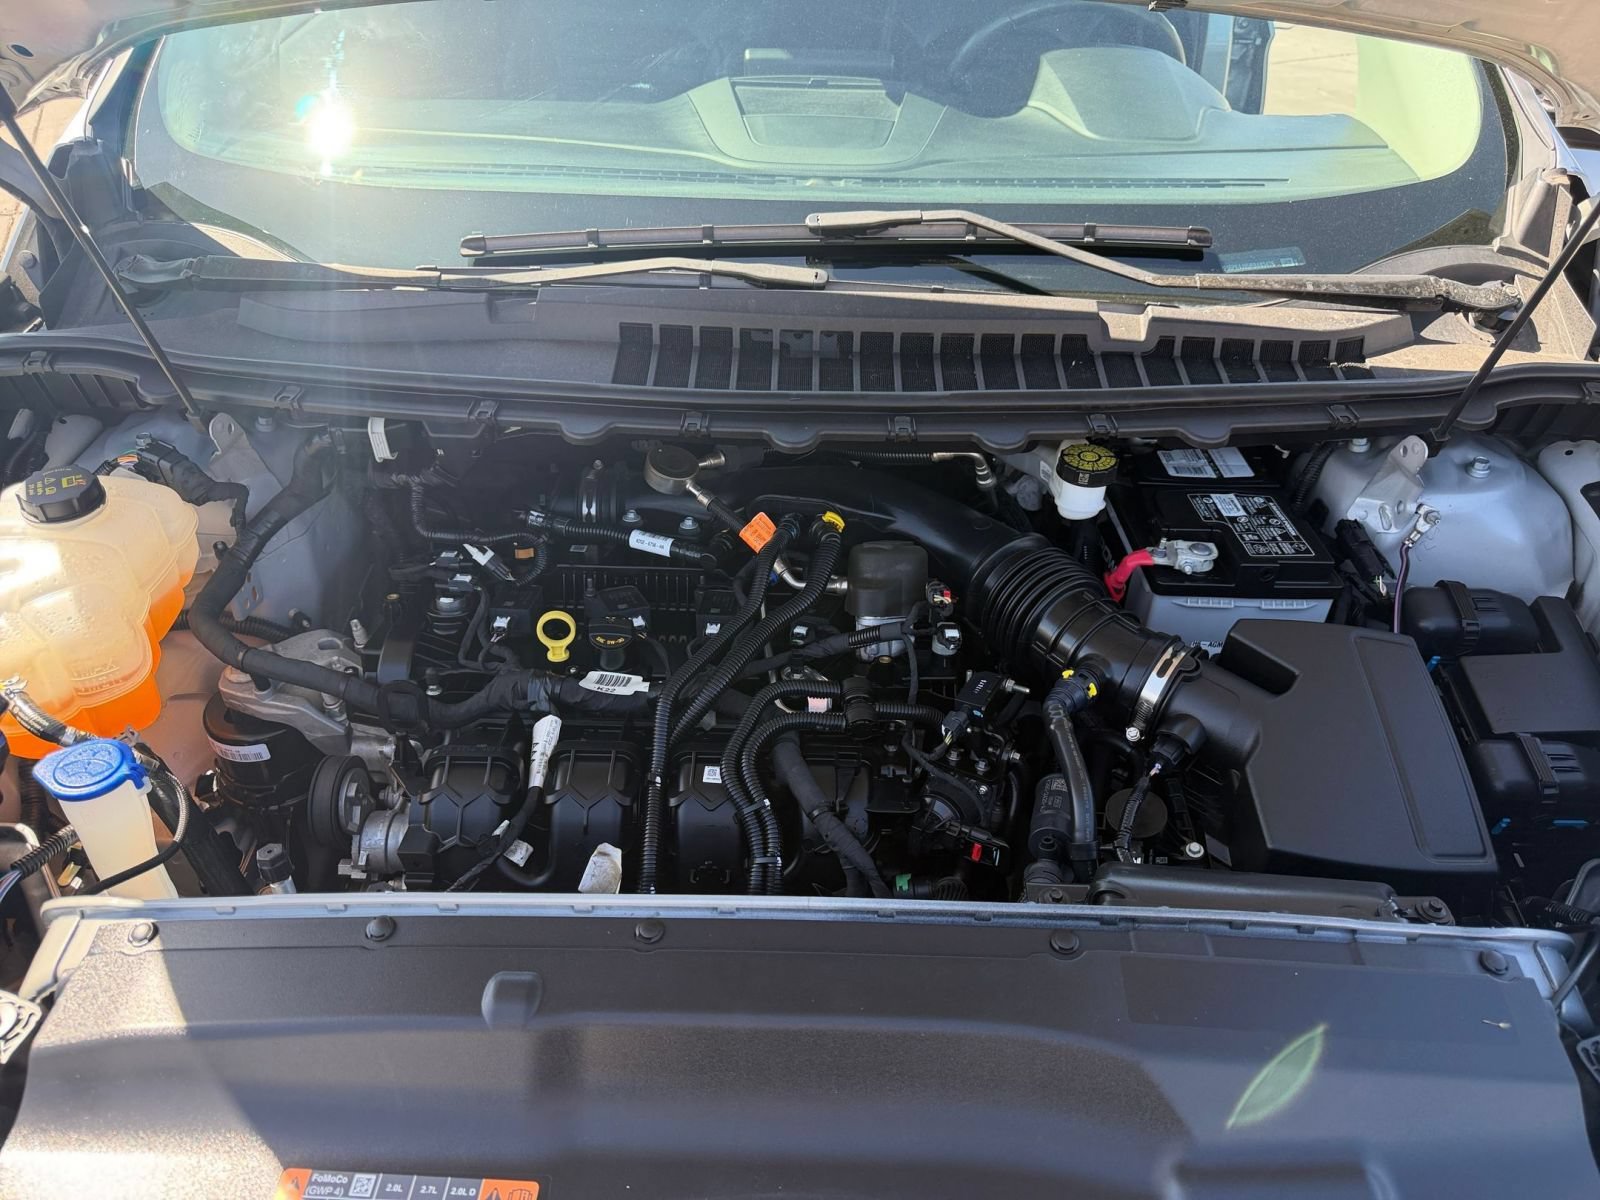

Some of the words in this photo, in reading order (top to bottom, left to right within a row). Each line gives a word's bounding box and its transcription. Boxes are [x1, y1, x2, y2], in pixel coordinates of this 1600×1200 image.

[312, 1173, 348, 1184] FoMoCo
[305, 1185, 333, 1196] (GWP
[333, 1187, 344, 1197] 4)
[385, 1183, 403, 1193] 2.0L
[420, 1185, 437, 1194] 2.7L
[450, 1187, 467, 1196] 2.0L
[469, 1188, 476, 1196] D
